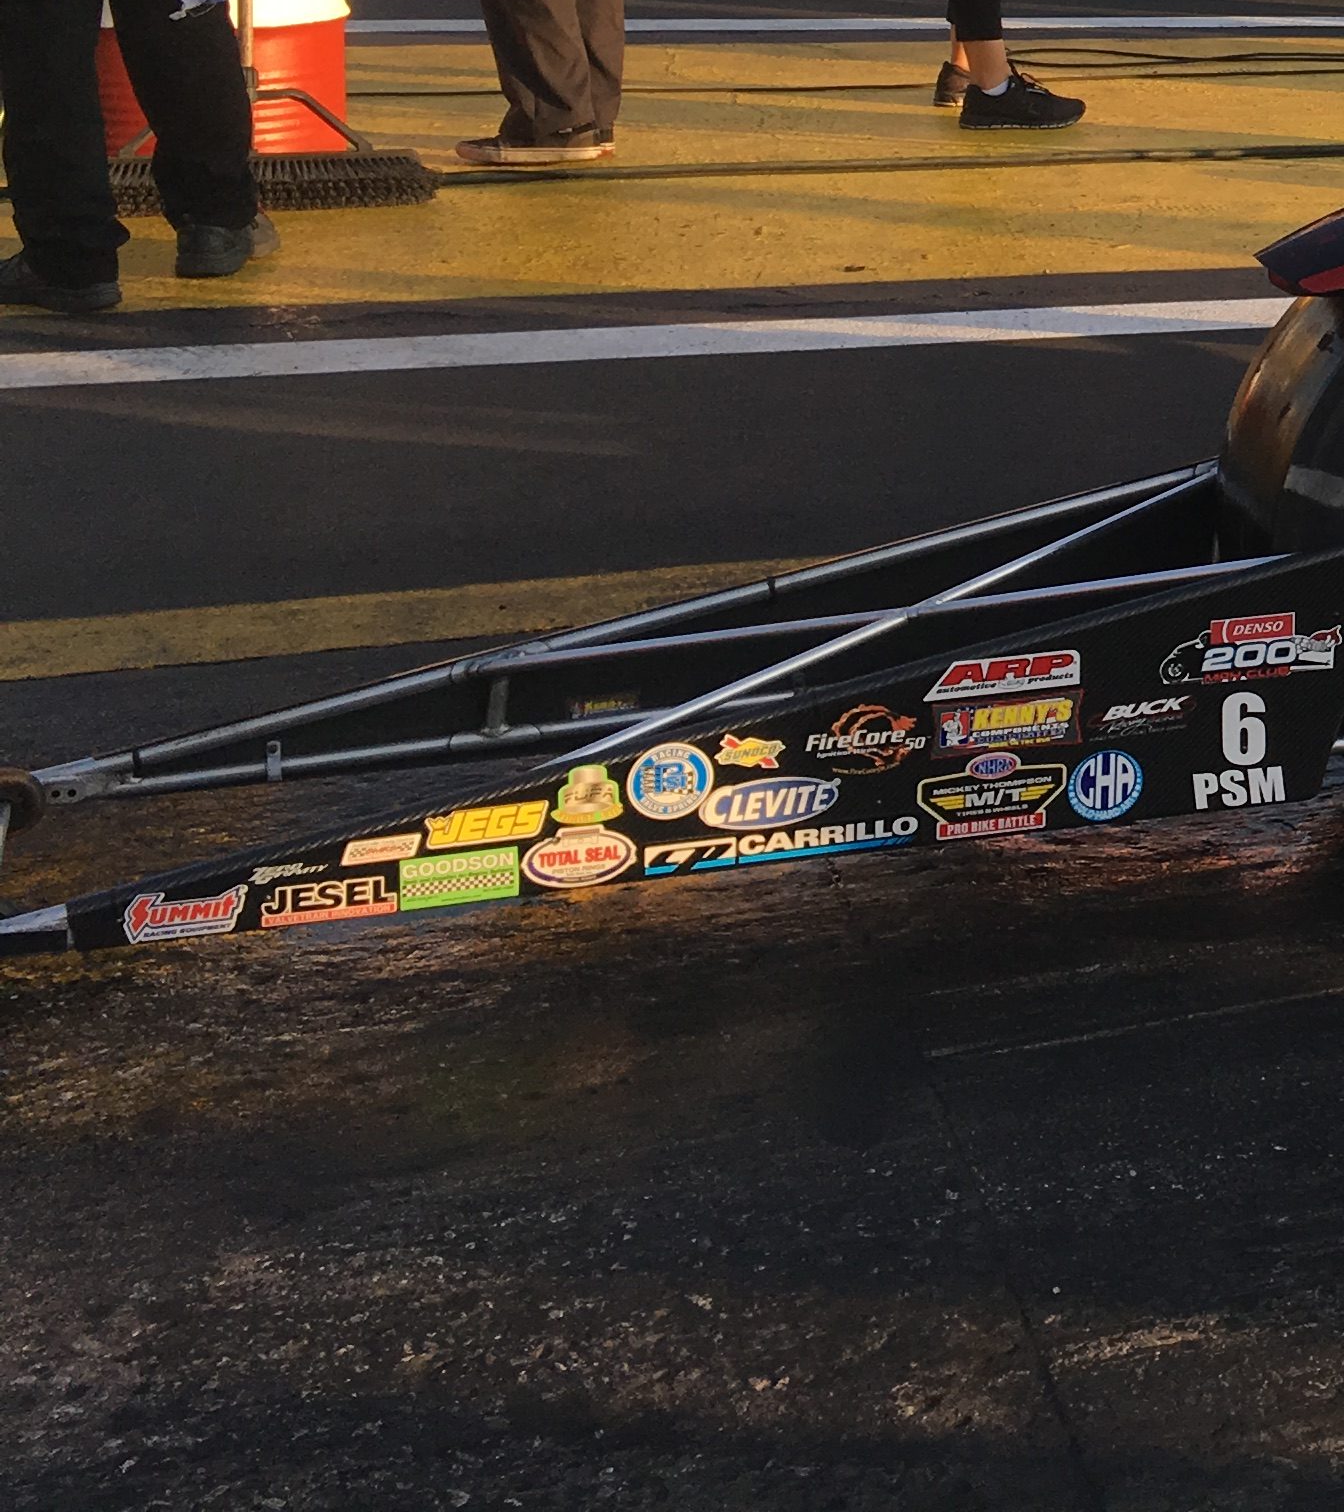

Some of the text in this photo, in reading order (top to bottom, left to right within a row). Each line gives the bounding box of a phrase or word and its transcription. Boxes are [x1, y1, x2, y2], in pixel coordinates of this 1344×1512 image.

[1232, 620, 1285, 636] DENSO
[1203, 640, 1299, 672] 200
[939, 653, 1075, 687] ARP
[1246, 666, 1291, 678] CLUB
[936, 672, 1074, 695] automotive products
[973, 698, 1074, 731] KENNY'S
[1102, 694, 1192, 722] BUCK
[804, 728, 926, 752] FireCore 50
[972, 721, 1070, 738] COMPONENTS
[1221, 691, 1267, 766] 6
[653, 749, 691, 761] RACING
[724, 743, 778, 761] SUNOCO
[978, 759, 1014, 774] NHRA
[932, 775, 1052, 796] MICKEY THOMPSON
[1075, 753, 1136, 810] CHA
[1192, 765, 1286, 811] PSM
[704, 783, 834, 827] CLEVITE
[965, 788, 1027, 809] M/T
[957, 810, 983, 818] TIRES
[993, 804, 1029, 814] WHEELS
[428, 805, 546, 846] JEGS
[738, 816, 919, 856] CARRILLO
[946, 813, 1037, 837] PRO BIKE BATTLE
[402, 852, 515, 881] GOODSON
[538, 844, 622, 868] TOTAL SEAL
[551, 866, 581, 876] PISTON
[261, 877, 397, 916] JESEL
[268, 904, 392, 926] VALVETRAIN INNOVATION
[143, 921, 232, 938] RACING EQUIPMENT
